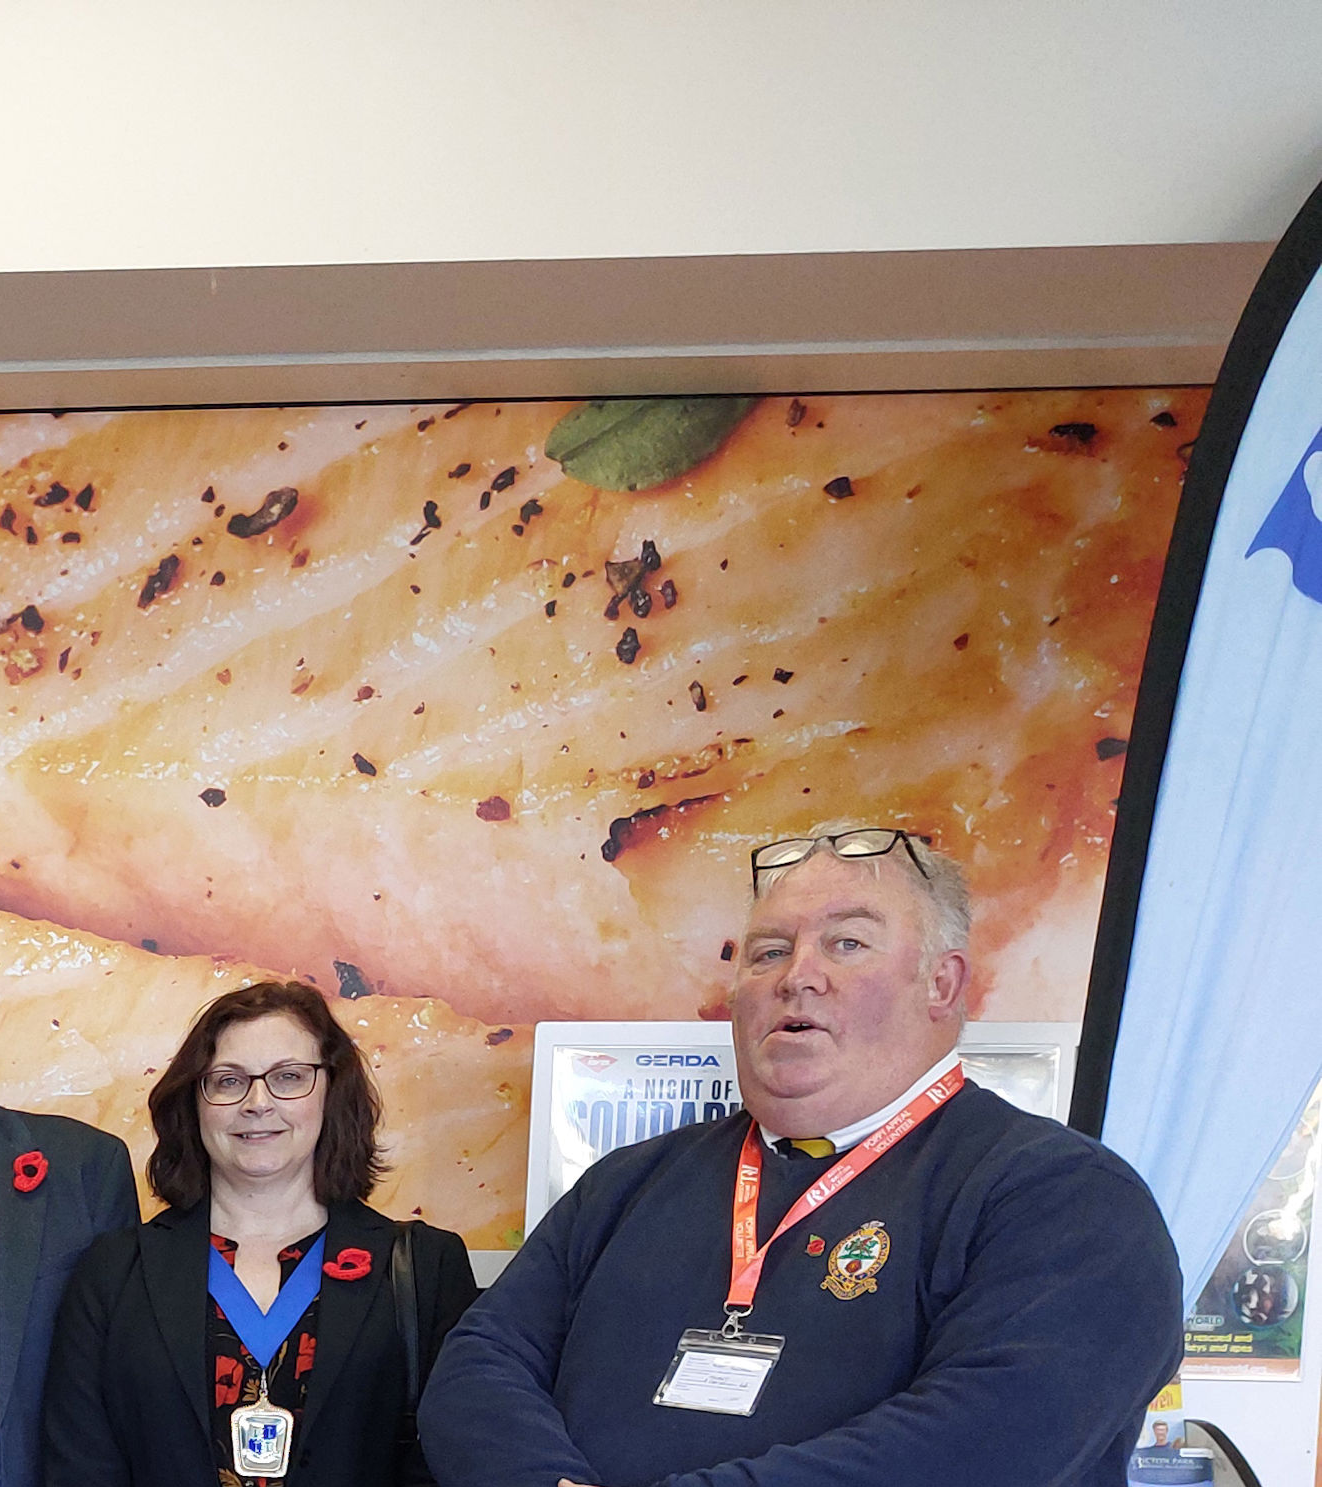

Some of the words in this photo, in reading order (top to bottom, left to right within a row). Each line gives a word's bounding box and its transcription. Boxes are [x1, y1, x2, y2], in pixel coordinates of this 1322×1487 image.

[635, 1054, 721, 1067] GERDA
[644, 1079, 703, 1100] NIGHT
[711, 1079, 733, 1100] OF
